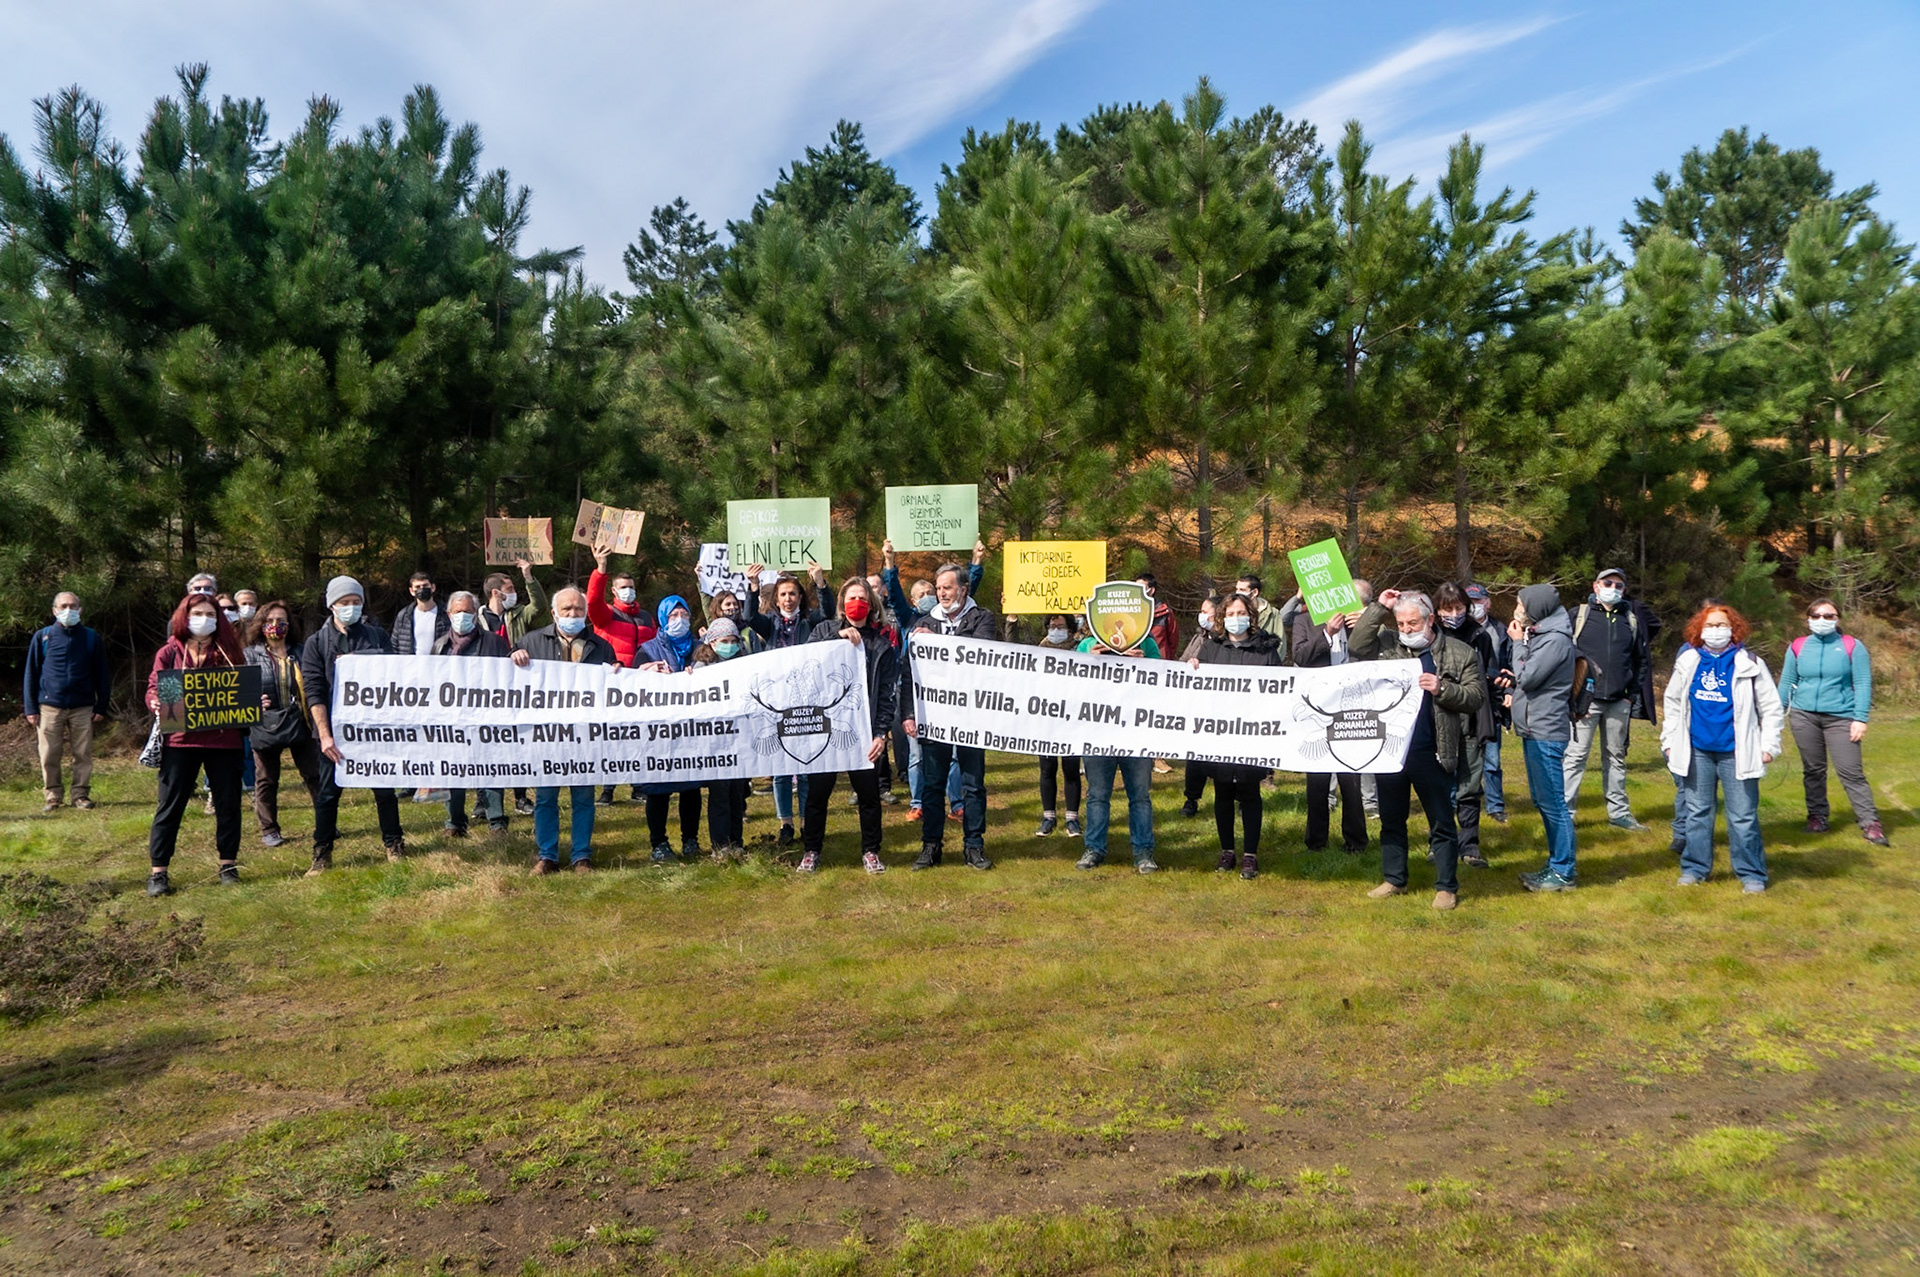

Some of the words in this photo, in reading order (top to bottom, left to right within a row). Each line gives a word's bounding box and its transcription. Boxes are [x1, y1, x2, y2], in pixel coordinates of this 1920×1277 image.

[901, 494, 942, 506] ORMANLAR
[740, 510, 778, 525] BEYKOZ
[914, 530, 951, 547] DEĞİL
[736, 539, 771, 566] ELİNİ
[780, 539, 817, 568] ÇEK
[1020, 549, 1073, 564] İKTİDARINIZ
[1042, 565, 1082, 578] GİDECEK
[1305, 567, 1333, 590] NEFESİ
[1107, 590, 1131, 598] KUZEY
[1307, 583, 1357, 616] KESİLMESİN
[1045, 596, 1090, 611] KALACA
[1097, 598, 1142, 606] ORMANLARI
[1097, 606, 1142, 614] SAVUNMASI
[910, 641, 949, 662] Çevre
[955, 645, 1037, 673] Şehircilik
[1165, 669, 1252, 693] itirazımız
[1258, 676, 1295, 694] var!
[184, 671, 240, 691] BEYKOZ
[184, 690, 239, 711] ÇEVRE
[343, 681, 430, 709] Beykoz
[439, 682, 595, 709] Ormanlarına
[605, 680, 730, 708] Dokunma!
[187, 706, 260, 729] SAVUNMASI
[792, 708, 815, 717] KUZEY
[974, 689, 1020, 715] Villa,
[1027, 696, 1071, 722] Otel,
[1078, 702, 1126, 728] AVM,
[1134, 708, 1186, 731] Plaza
[1193, 717, 1287, 736] yapılmaz.
[1343, 711, 1368, 720] KUZEY
[783, 715, 824, 726] ORMANLARI
[1333, 720, 1377, 730] ORMANLARI
[343, 723, 417, 742] Ormana
[422, 725, 472, 746] Villa,
[479, 725, 525, 745] Otel,
[532, 723, 581, 744] AVM,
[589, 723, 641, 742] Plaza
[648, 718, 739, 741] yapılmaz.
[784, 724, 824, 735] SAVUNMASI
[917, 722, 945, 740] eykoz
[950, 726, 979, 745] Kent
[1333, 729, 1377, 739] SAVUNMASI
[345, 759, 397, 777] Beykoz
[402, 760, 435, 776] Kent
[440, 760, 537, 778] Dayanışması,
[543, 759, 595, 777] Beykoz
[601, 758, 640, 774] Çevre
[647, 754, 738, 773] Dayanışması
